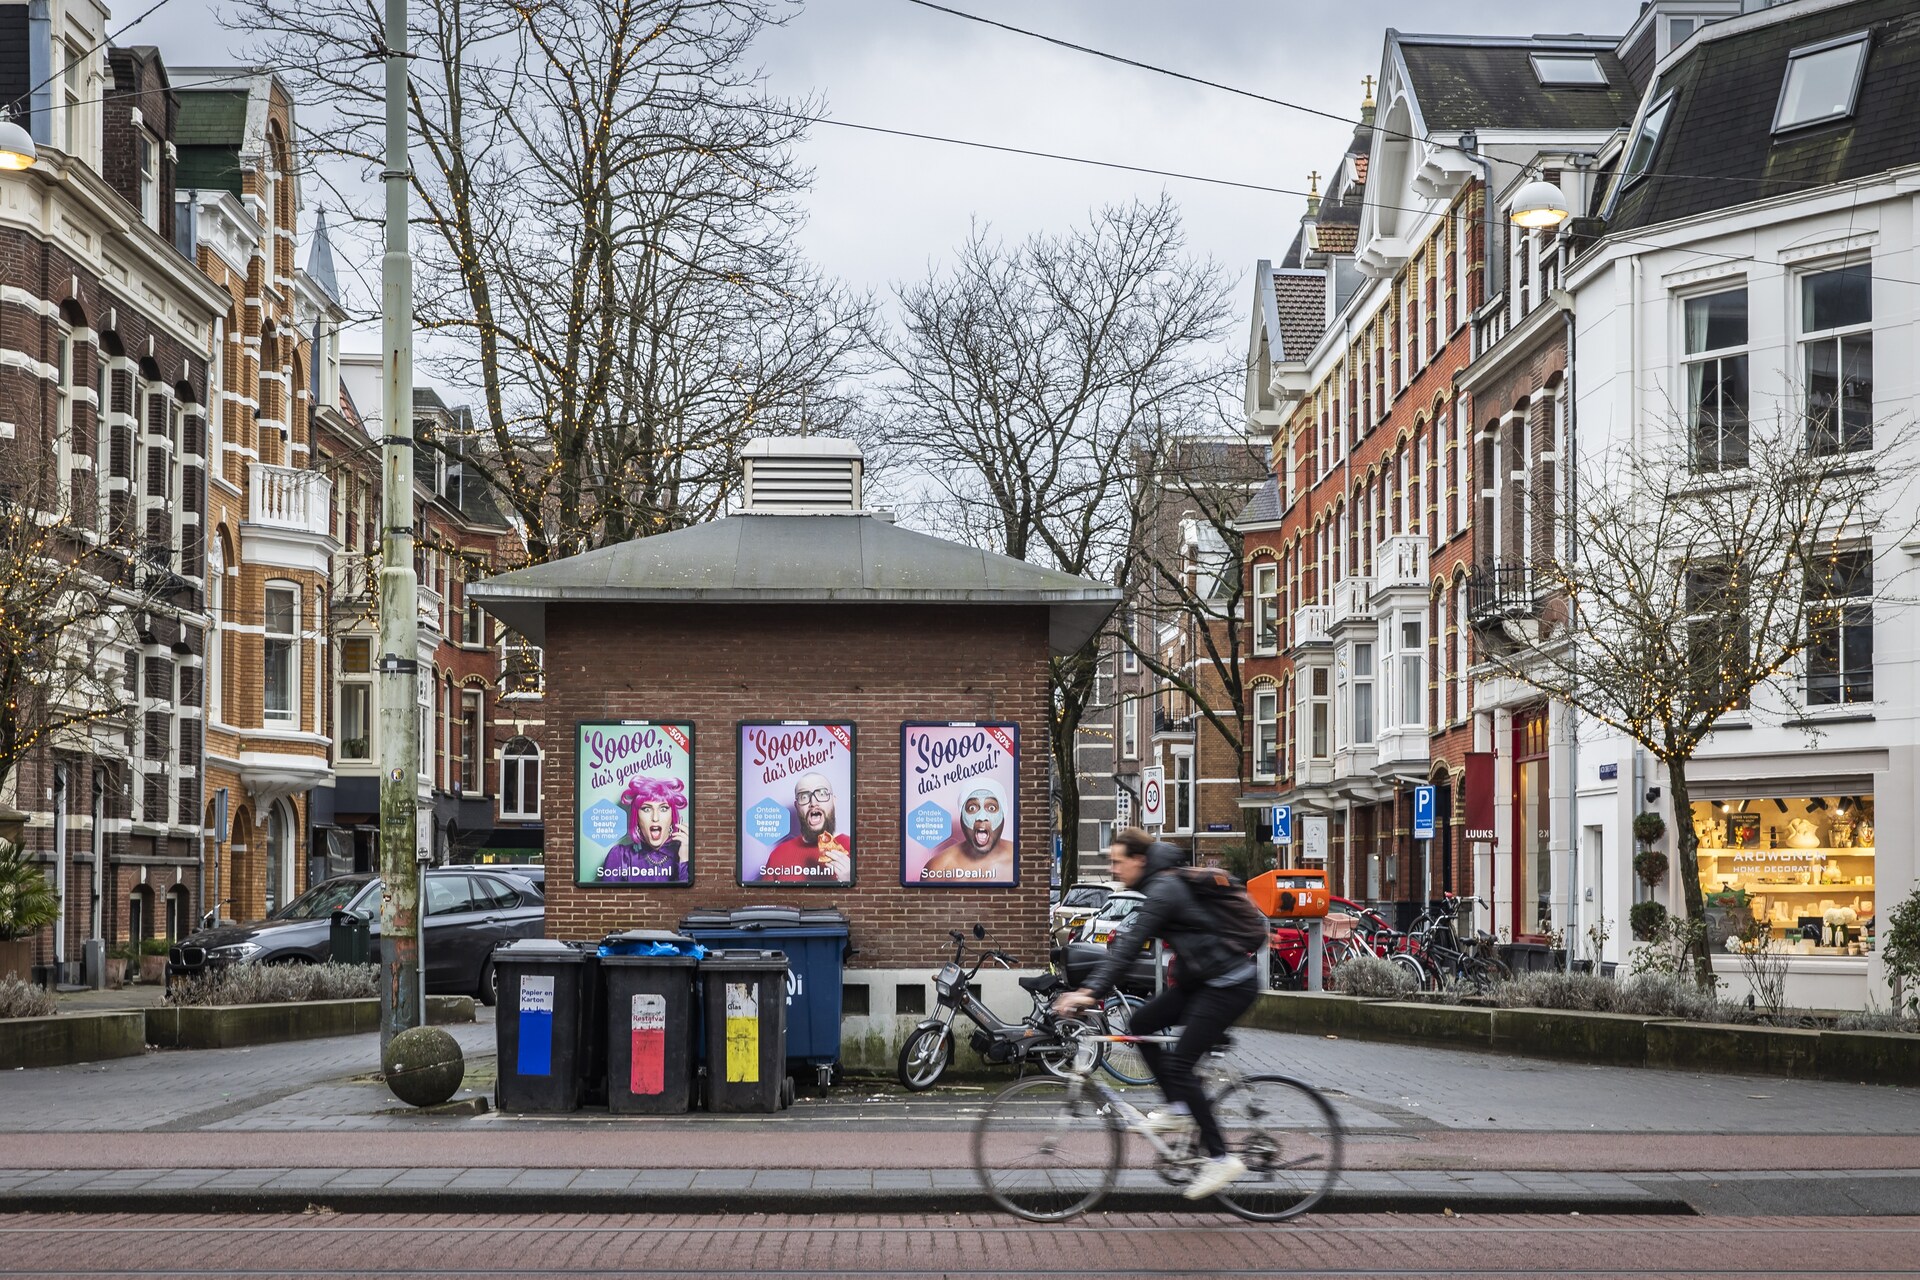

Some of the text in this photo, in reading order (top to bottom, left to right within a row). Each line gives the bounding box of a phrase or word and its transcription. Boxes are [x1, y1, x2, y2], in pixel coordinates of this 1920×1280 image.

[668, 726, 686, 746] -50%
[832, 726, 850, 746] -50%
[993, 729, 1011, 749] -50%
[1148, 790, 1157, 802] 30
[1419, 790, 1430, 813] P
[1276, 808, 1287, 825] P
[1465, 829, 1494, 838] LUUKS
[1733, 851, 1827, 862] AROWONEN
[597, 866, 672, 877] SocialDeal.nl
[759, 865, 834, 876] SocialDeal.nl
[921, 868, 996, 879] SocialDeal.nl
[1764, 865, 1827, 873] DECORATION
[521, 989, 542, 997] Papier
